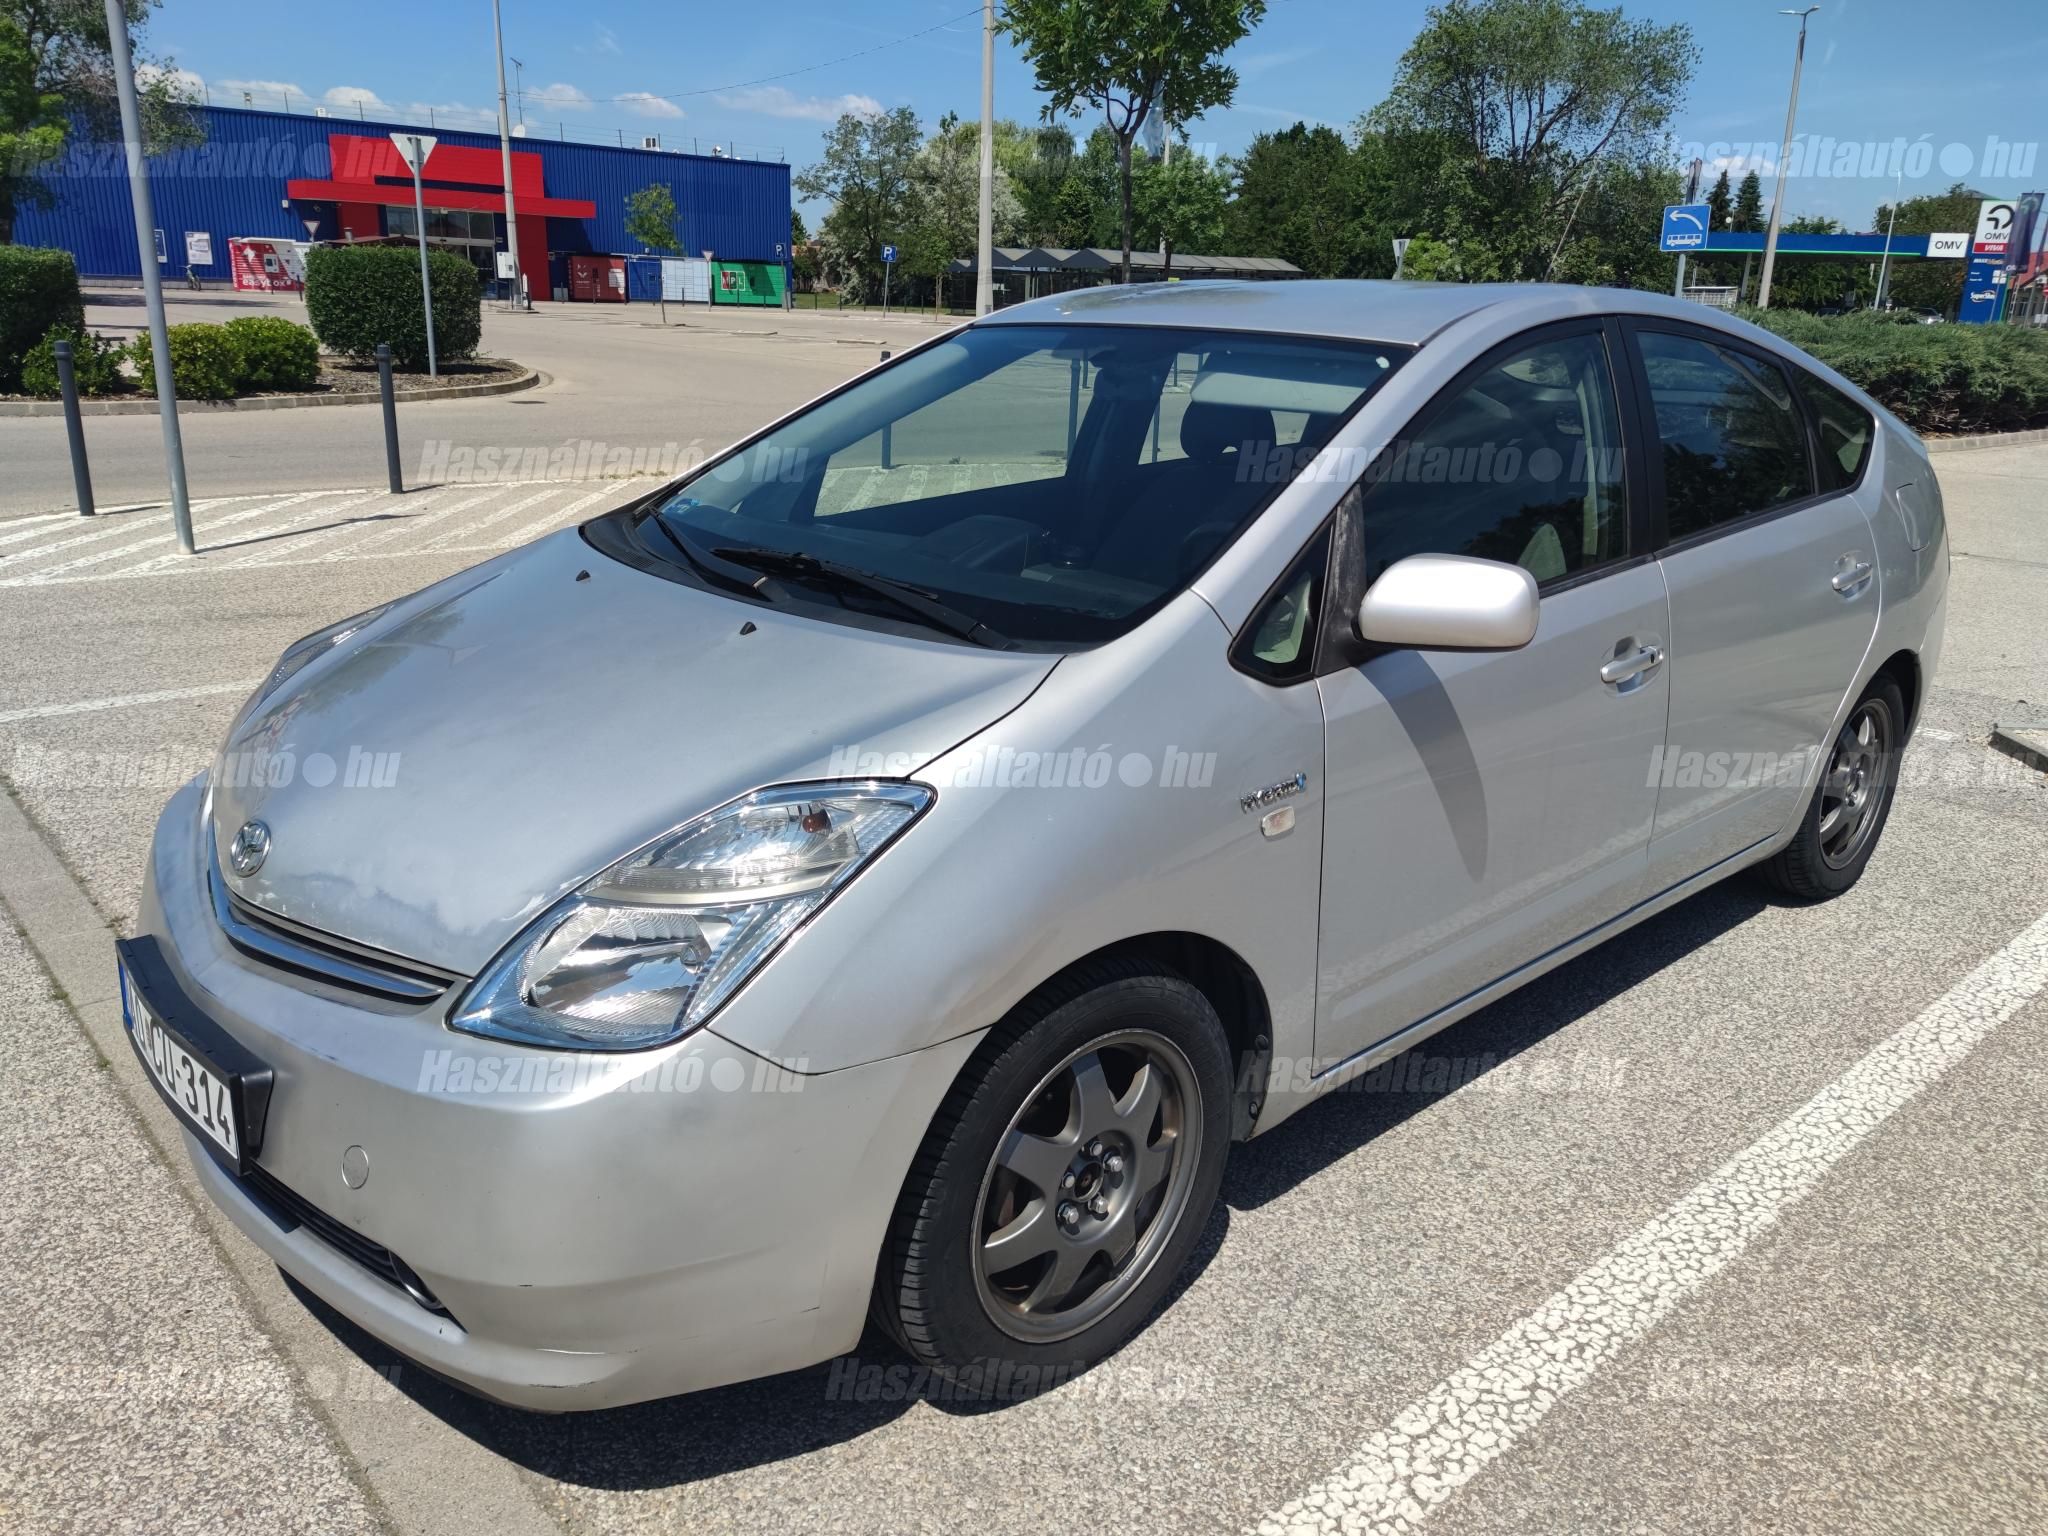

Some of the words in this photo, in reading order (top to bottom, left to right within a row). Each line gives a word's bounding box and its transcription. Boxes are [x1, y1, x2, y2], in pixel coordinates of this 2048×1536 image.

[1984, 231, 2009, 241] OMV
[1934, 240, 1963, 250] OMV
[1984, 244, 2004, 252] VIVA
[150, 1022, 231, 1145] CU-314
